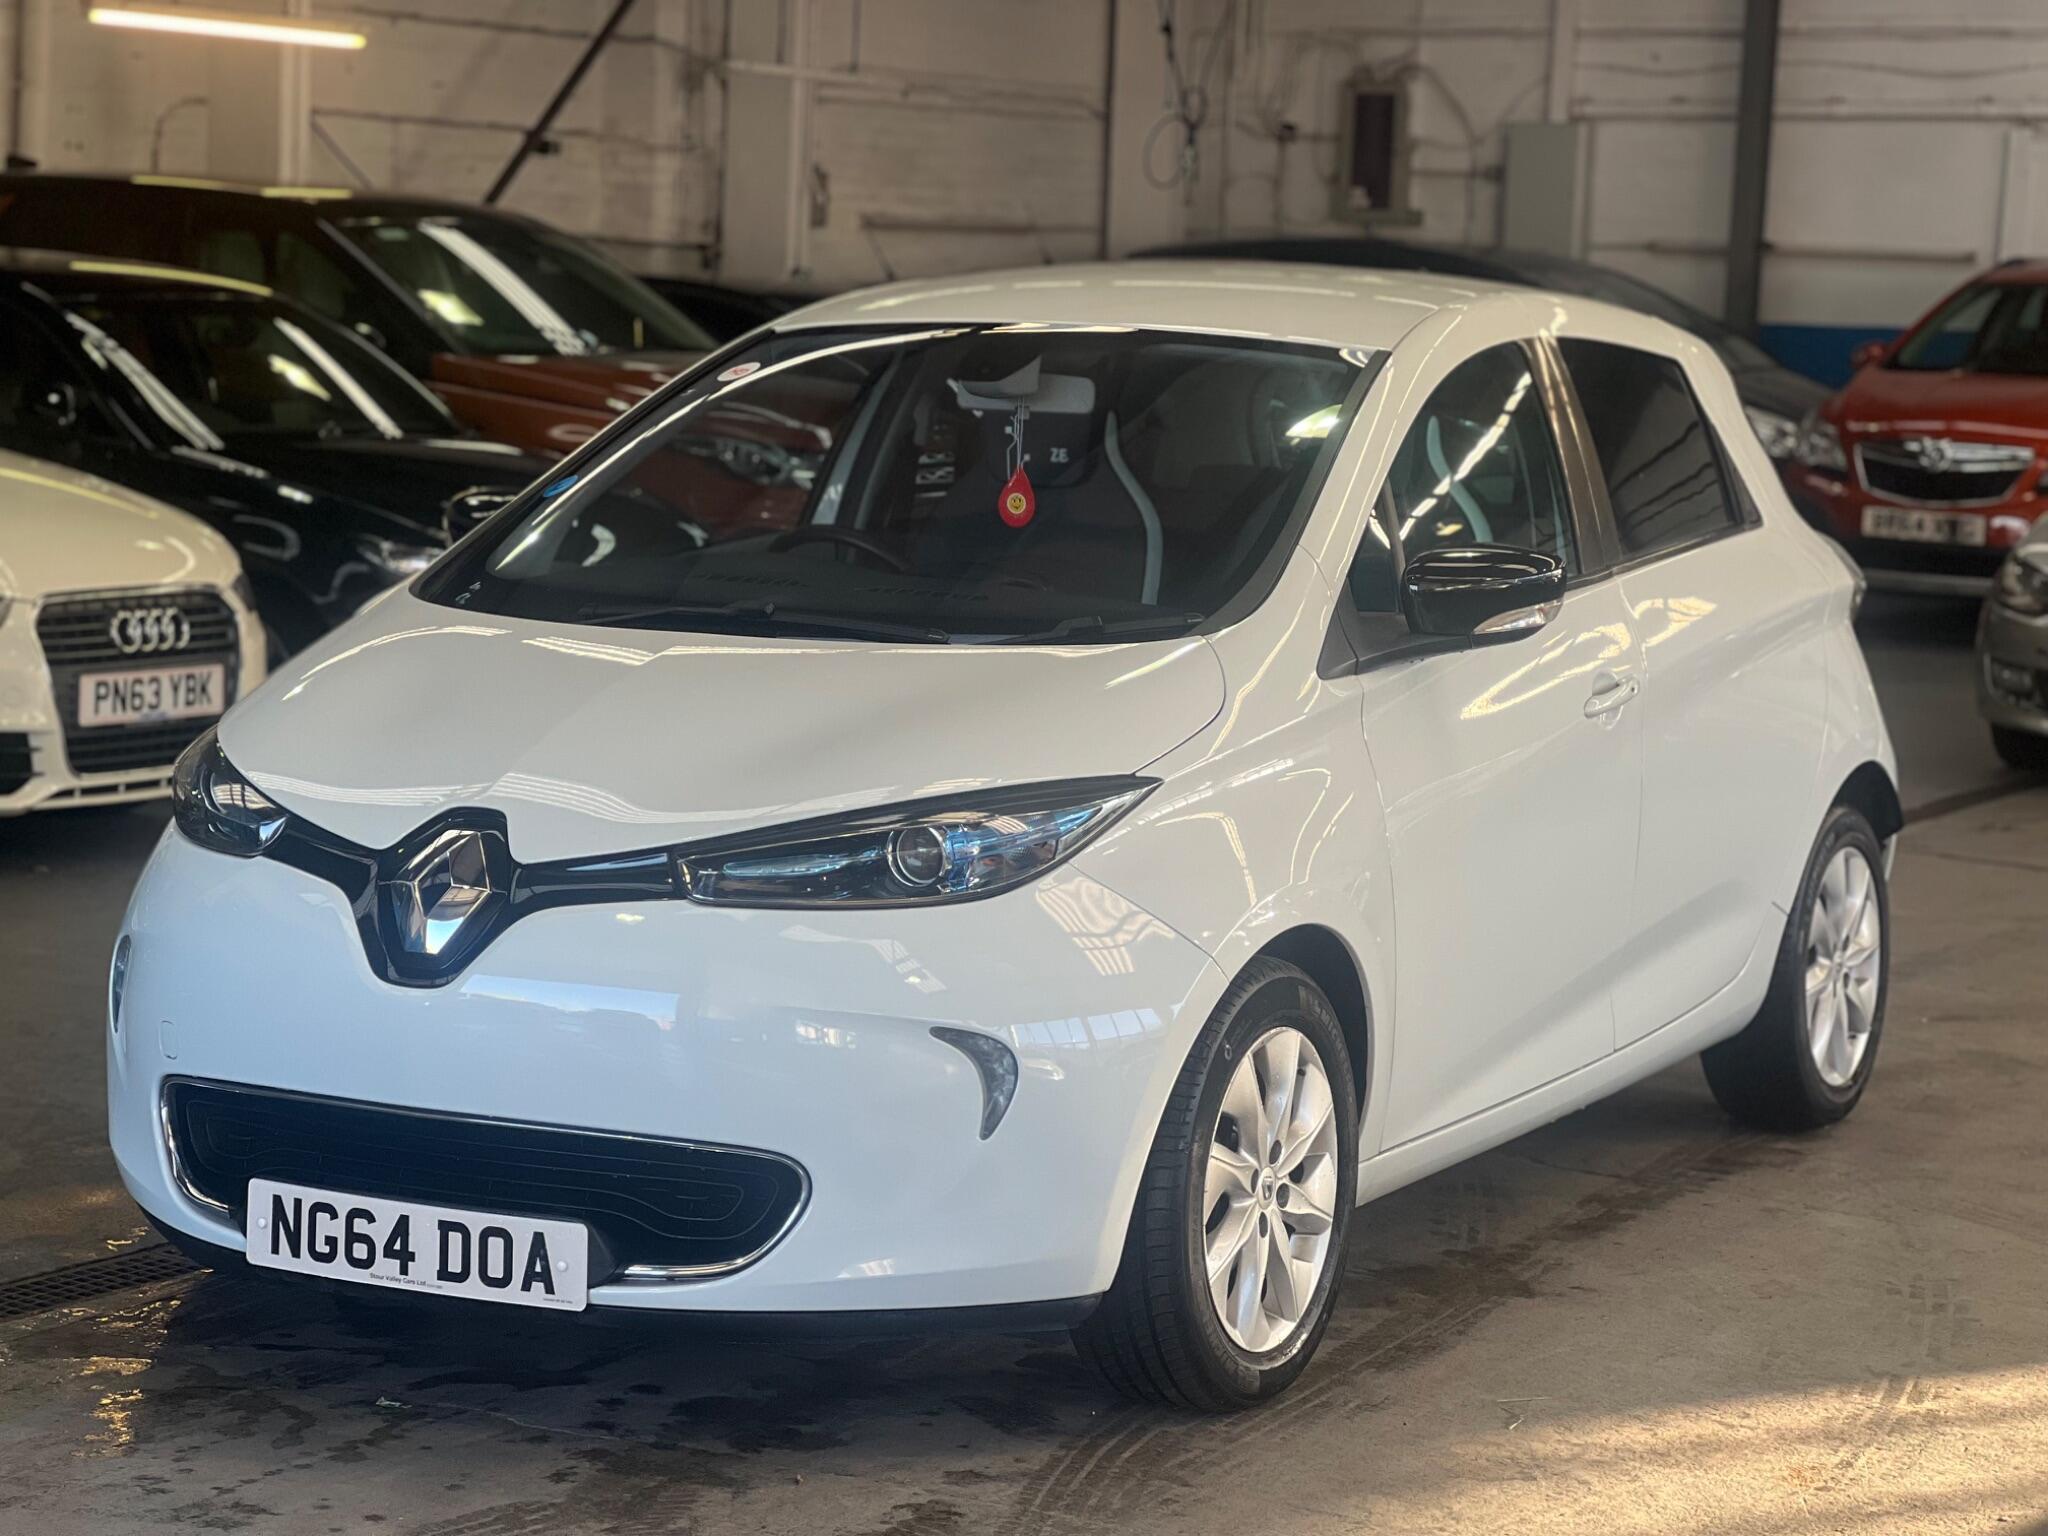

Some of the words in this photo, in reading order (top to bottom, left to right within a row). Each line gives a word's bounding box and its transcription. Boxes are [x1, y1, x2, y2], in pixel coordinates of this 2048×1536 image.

[94, 676, 161, 715] PN63
[170, 672, 213, 708] YBK
[271, 1194, 416, 1276] NG64
[437, 1220, 556, 1295] DOA
